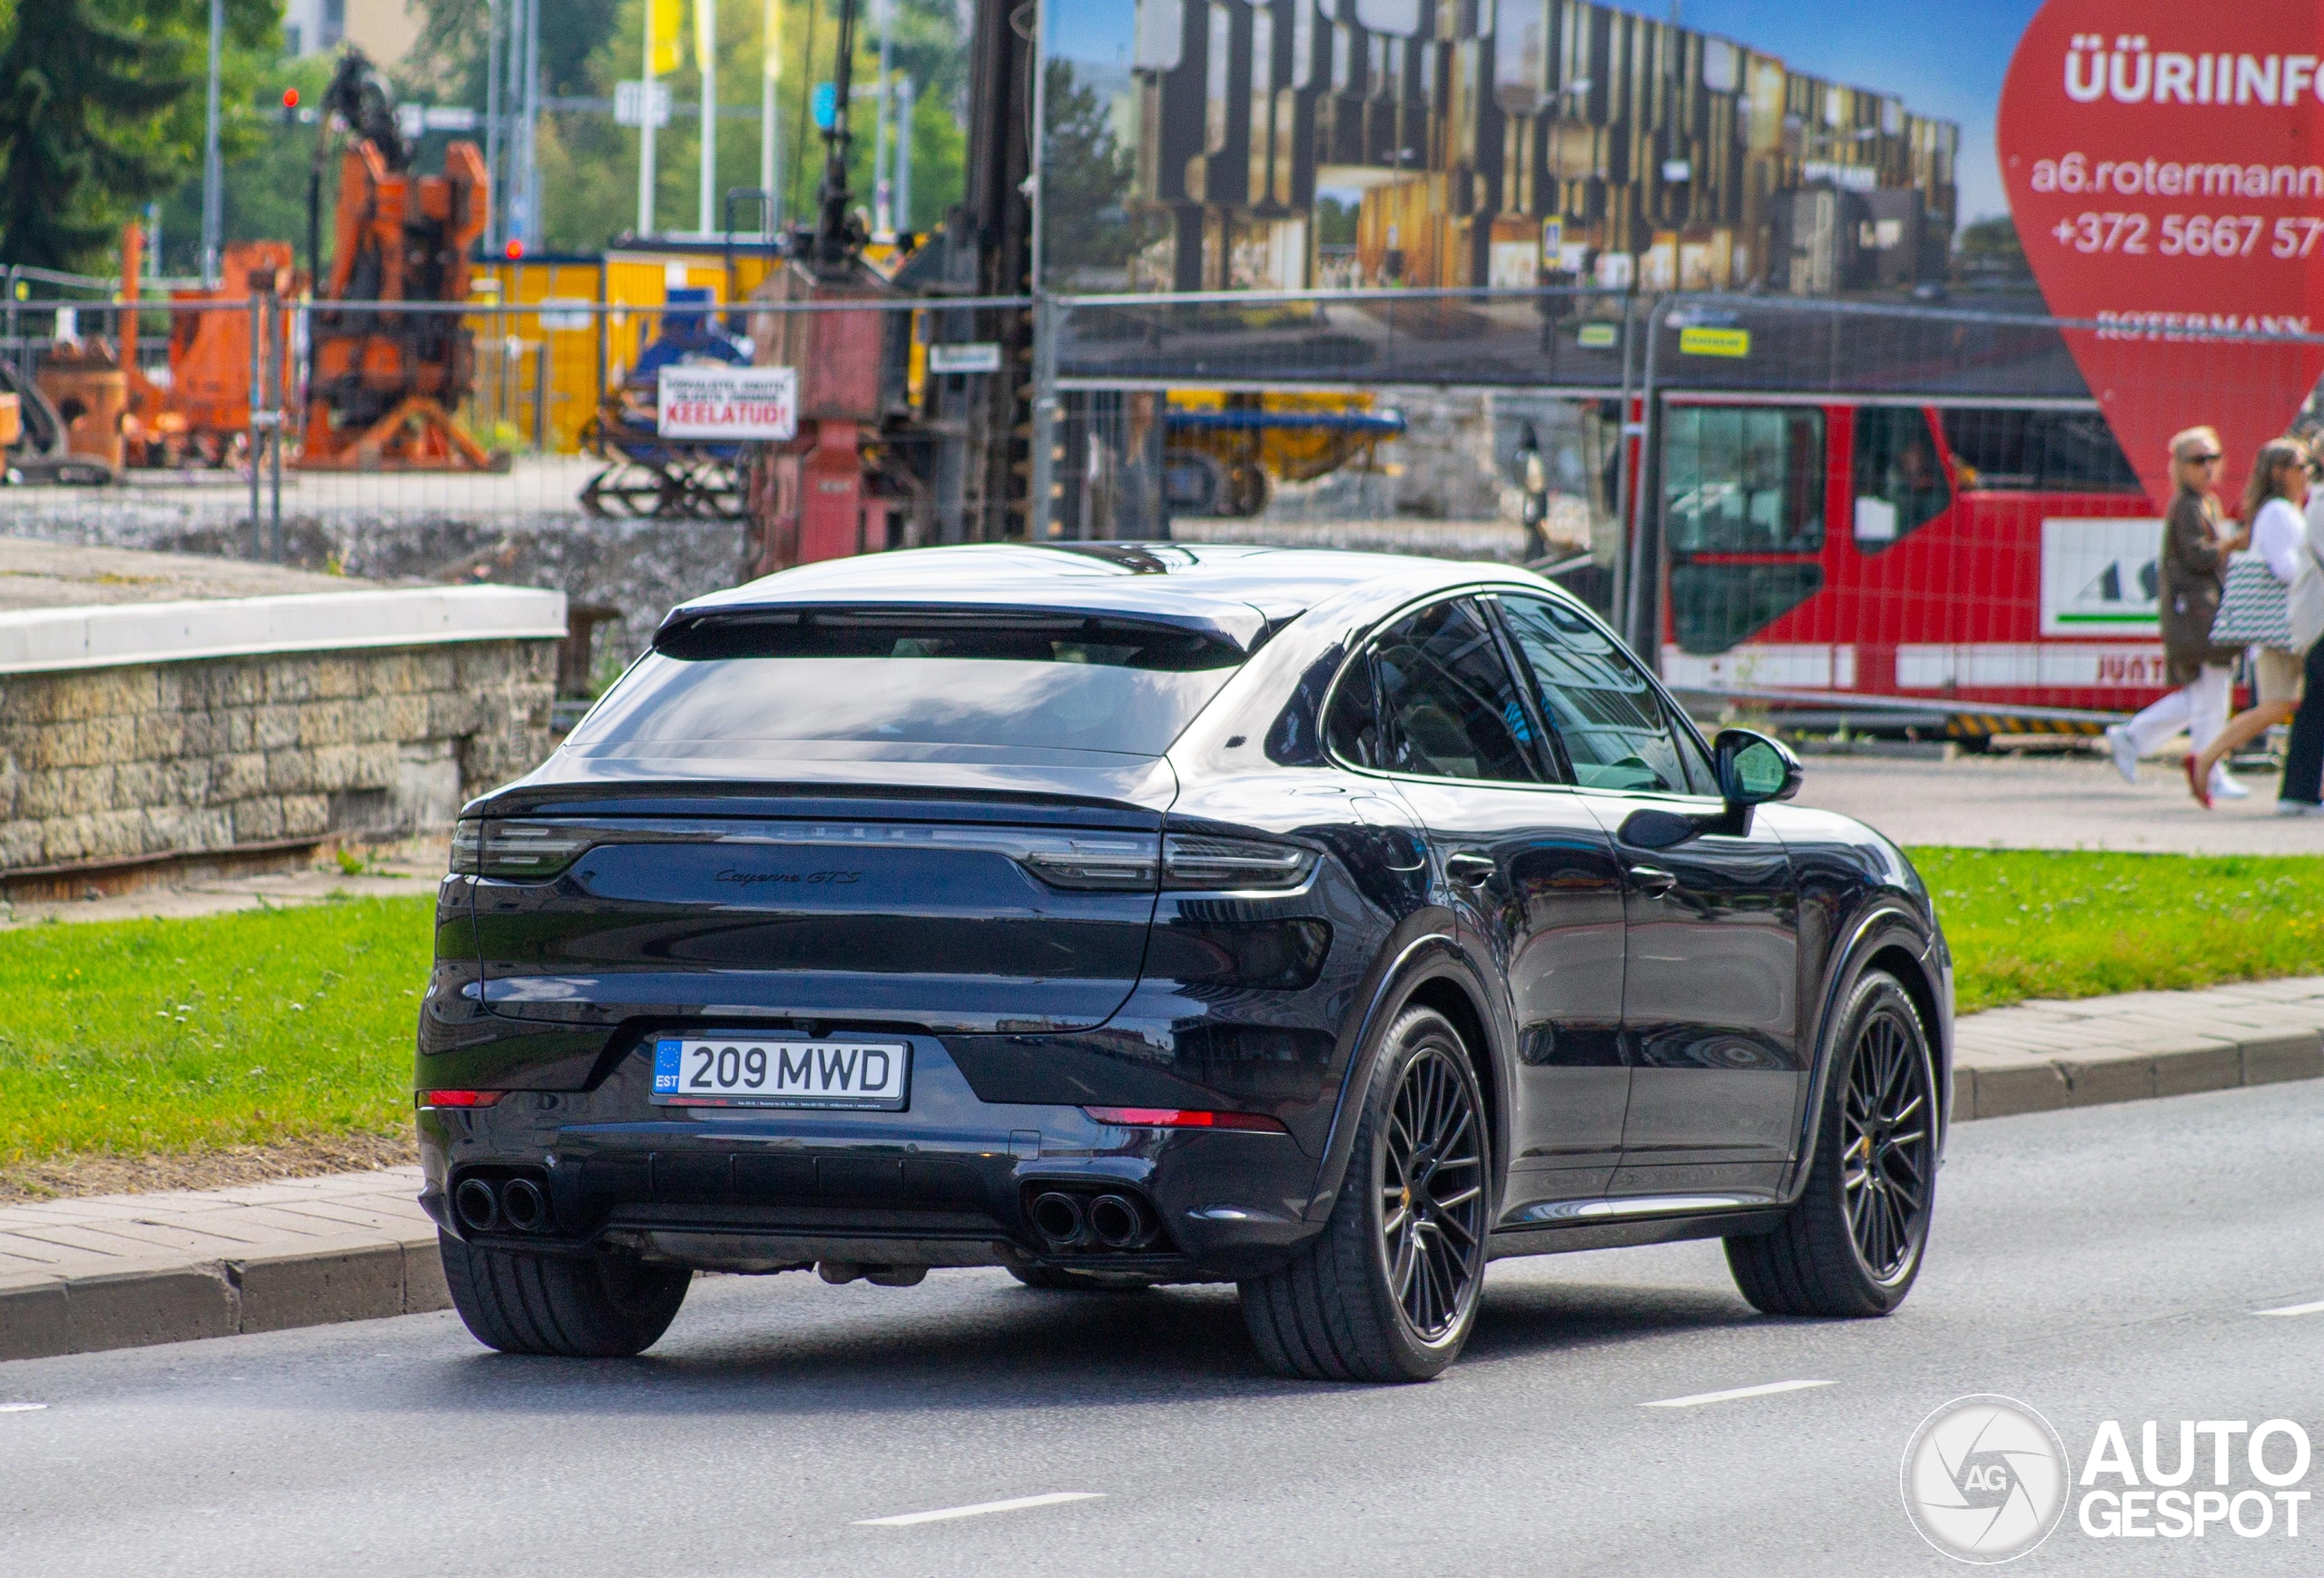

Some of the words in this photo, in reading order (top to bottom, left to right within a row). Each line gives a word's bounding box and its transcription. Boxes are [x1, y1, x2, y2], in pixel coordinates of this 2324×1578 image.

[2063, 33, 2324, 106] ÜÜRIINF
[2030, 151, 2324, 199] a6.rotermann
[2051, 211, 2150, 255] +372
[2158, 213, 2264, 258] 5667
[2270, 216, 2324, 260] 57
[666, 402, 786, 425] KEELATUD!
[714, 869, 801, 887] Cayenne
[807, 871, 862, 884] GTS
[655, 1075, 679, 1088] EST
[689, 1047, 767, 1088] 209
[776, 1048, 891, 1091] MWD
